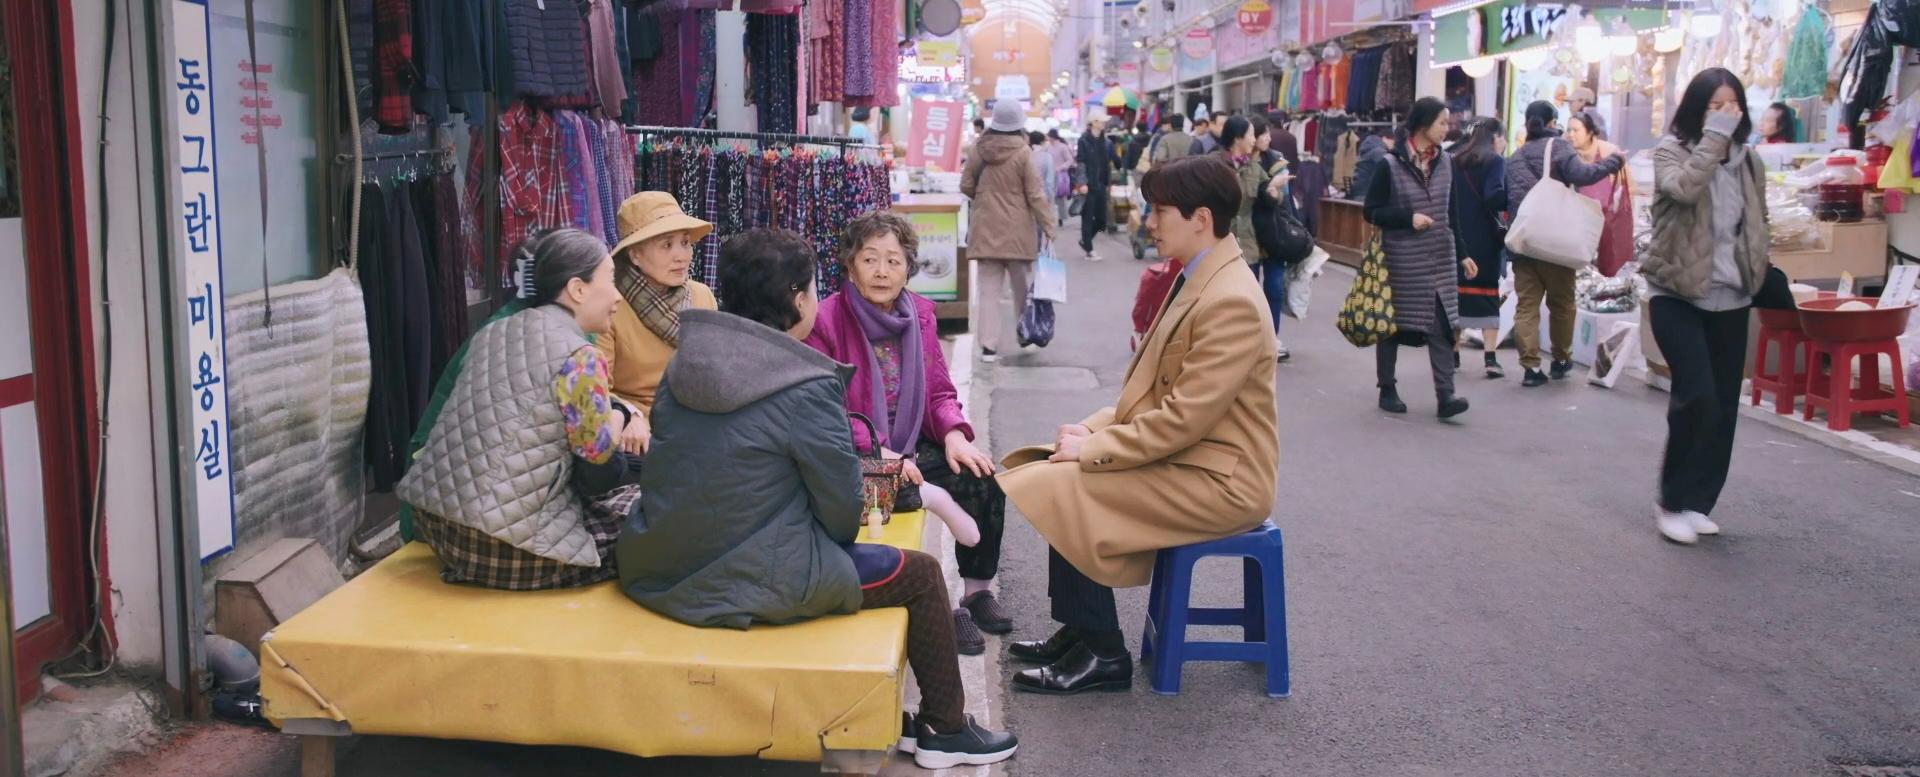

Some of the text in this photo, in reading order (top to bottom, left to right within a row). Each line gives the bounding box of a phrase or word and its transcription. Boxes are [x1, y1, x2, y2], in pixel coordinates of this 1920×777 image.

[922, 106, 950, 167] 등심
[177, 59, 223, 479] 동그란 미용실
